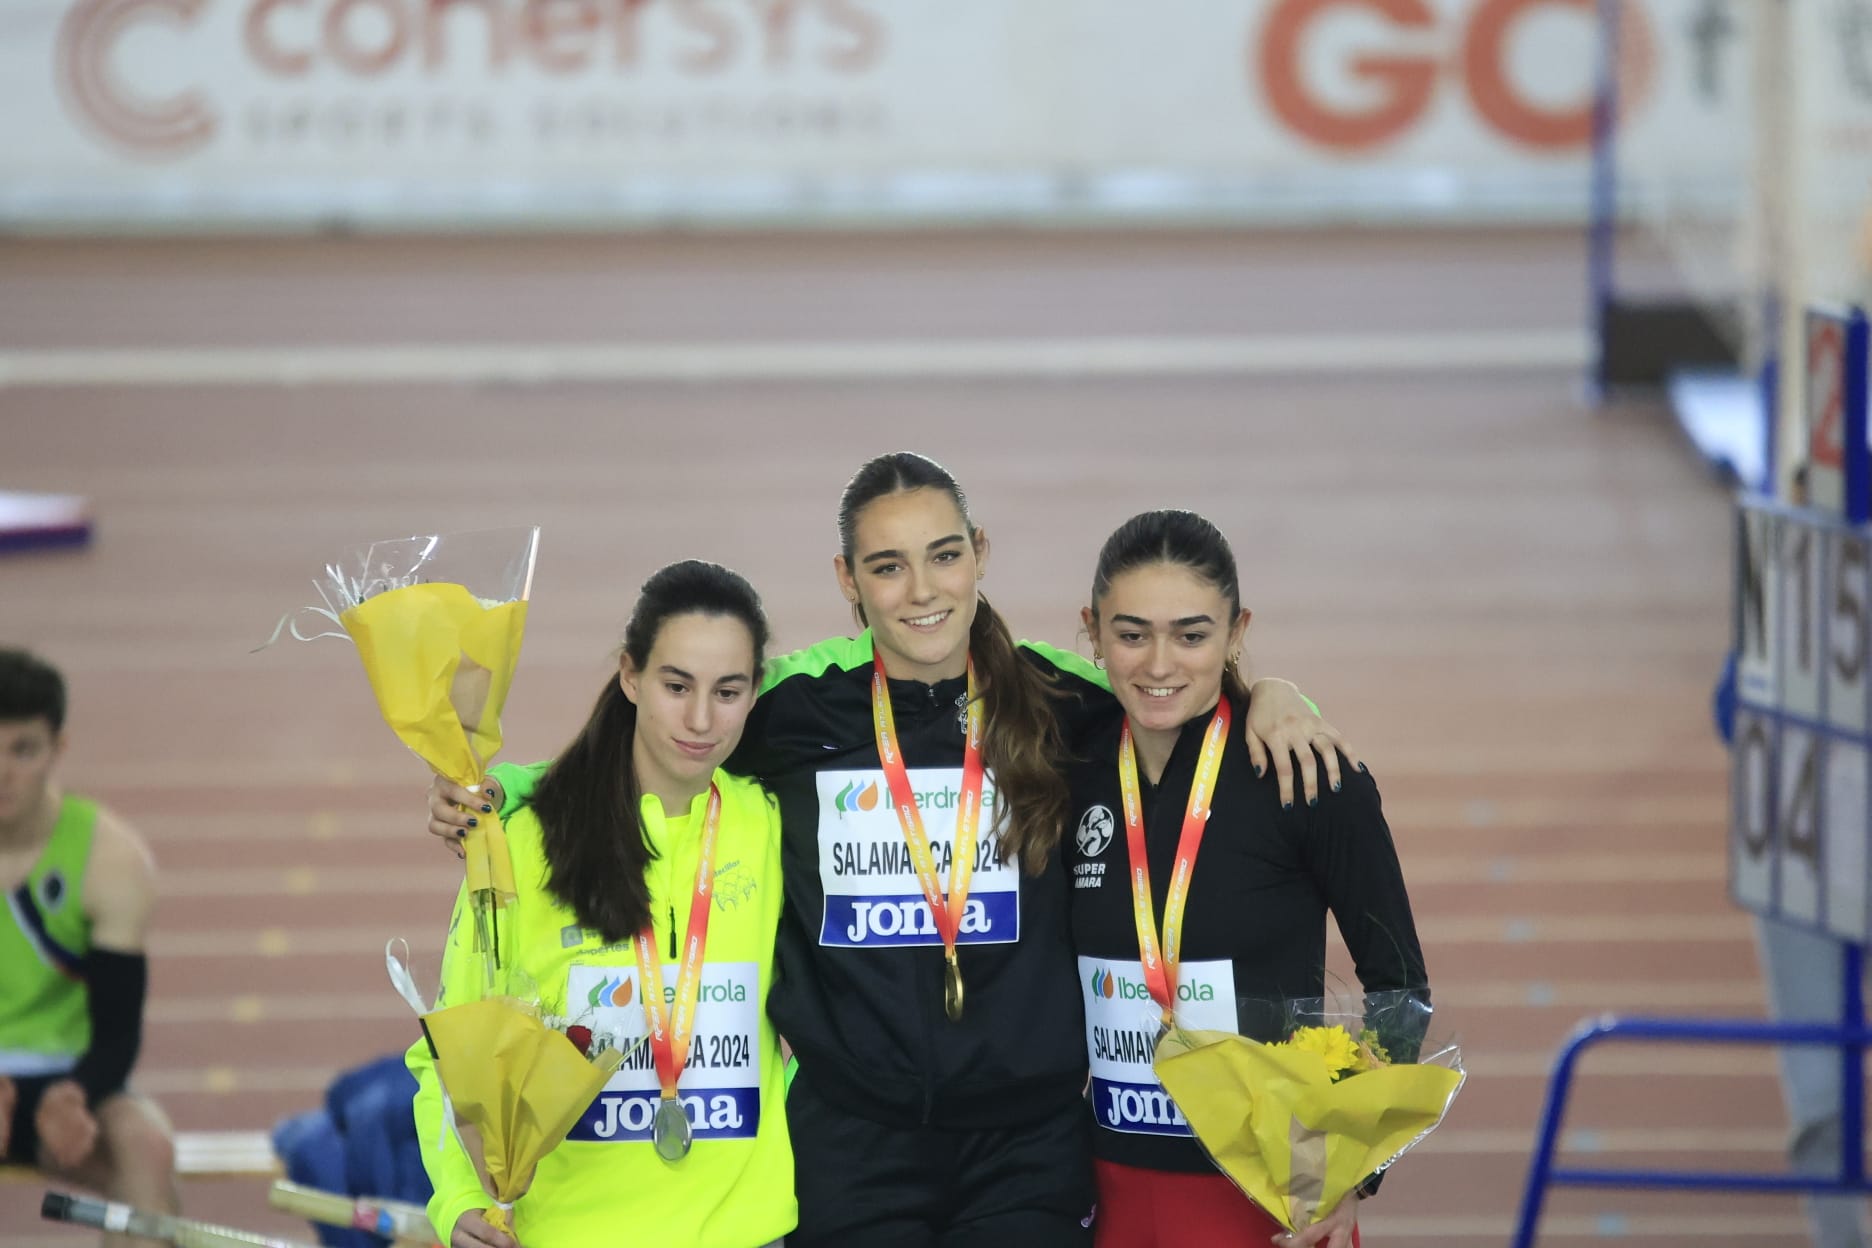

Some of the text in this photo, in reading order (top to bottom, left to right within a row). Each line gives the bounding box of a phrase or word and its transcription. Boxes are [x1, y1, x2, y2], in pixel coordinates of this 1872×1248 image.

[886, 785, 995, 809] Ierdra
[833, 840, 952, 876] SALAMACA
[1073, 863, 1106, 875] SUPER
[1117, 976, 1215, 1001] Ibeola
[710, 1034, 750, 1068] 2024
[1094, 1025, 1155, 1065] SALAMAN
[1107, 1086, 1188, 1126] Jom
